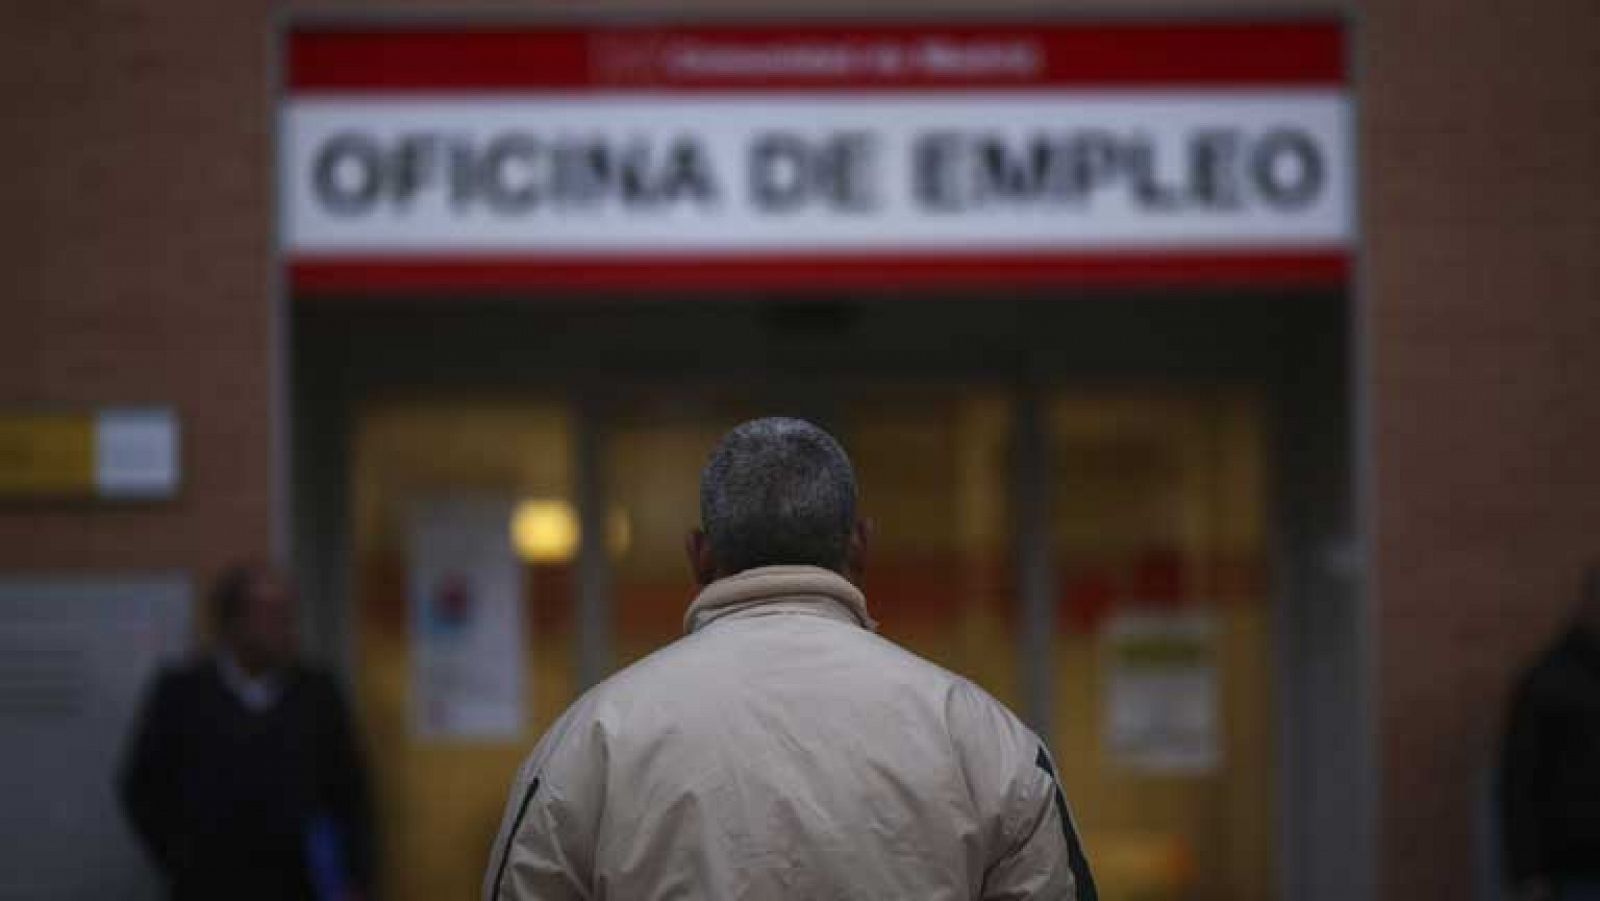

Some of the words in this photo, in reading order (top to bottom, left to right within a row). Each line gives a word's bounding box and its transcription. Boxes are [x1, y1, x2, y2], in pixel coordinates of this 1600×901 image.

[310, 131, 719, 215] OFICINA
[749, 132, 876, 213] DE
[911, 132, 1325, 213] EMPLEO
